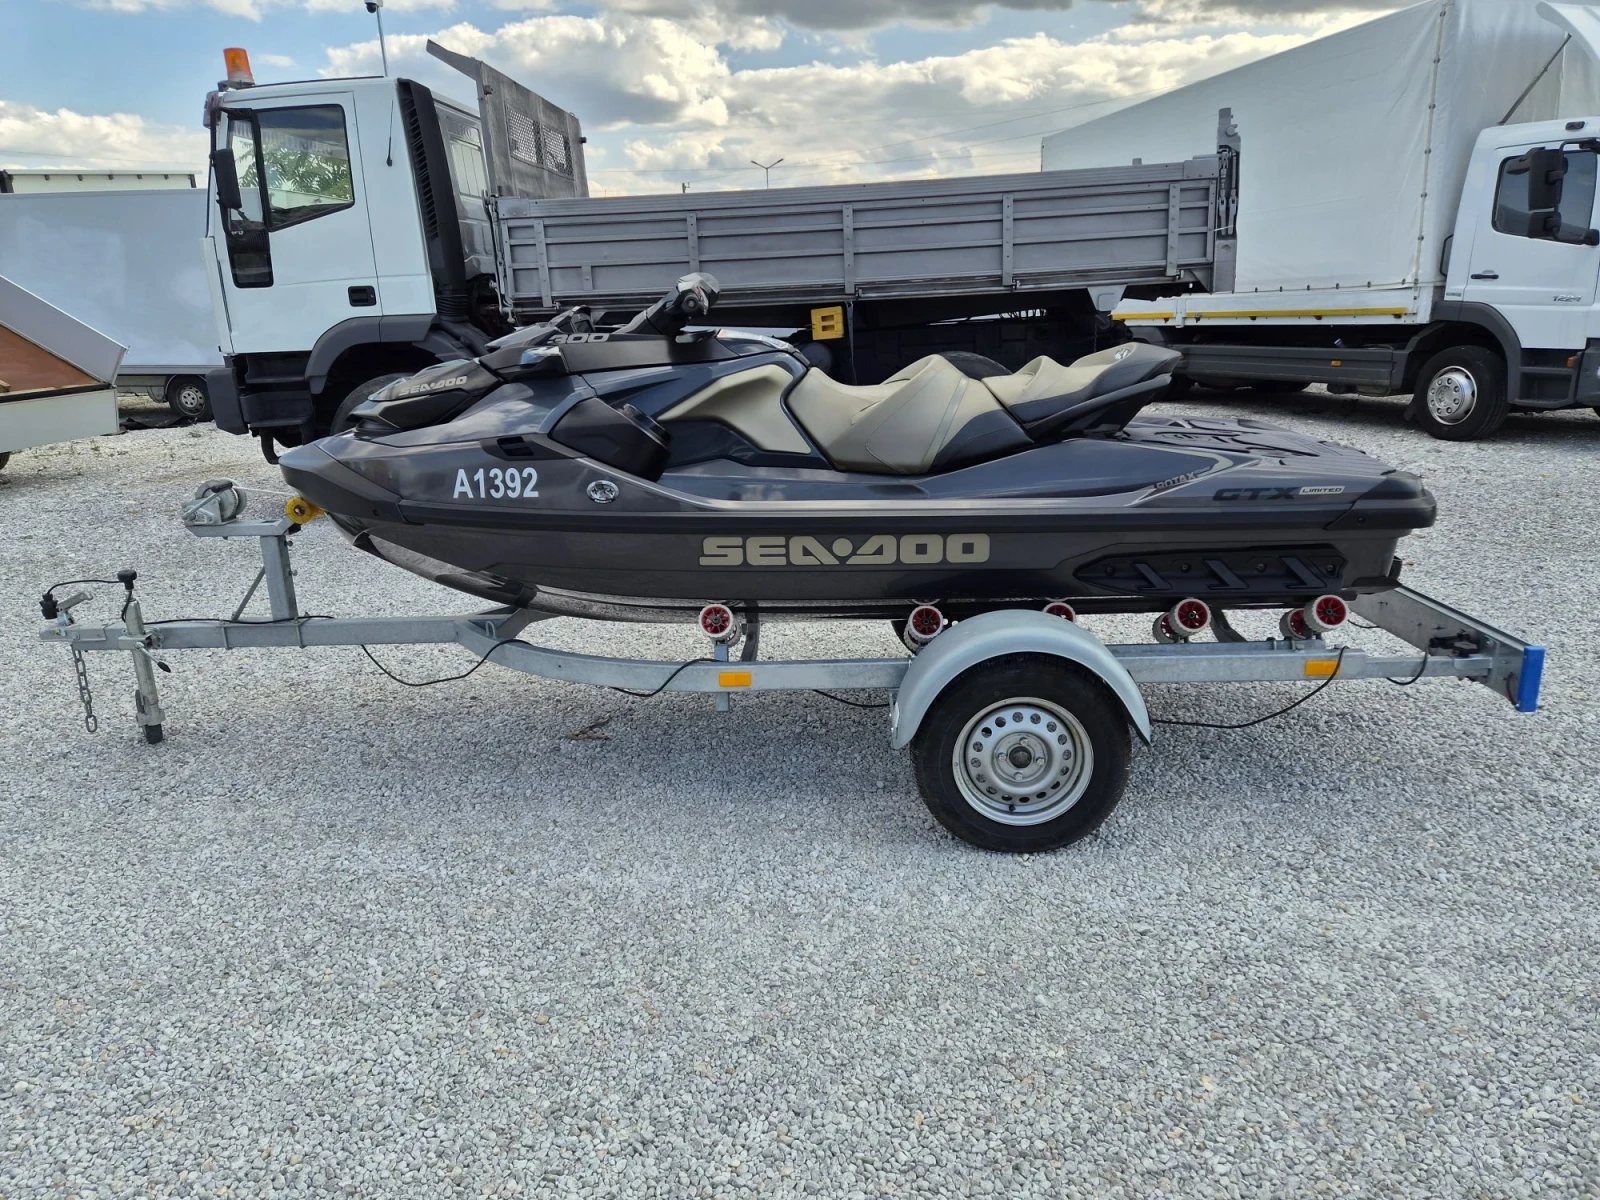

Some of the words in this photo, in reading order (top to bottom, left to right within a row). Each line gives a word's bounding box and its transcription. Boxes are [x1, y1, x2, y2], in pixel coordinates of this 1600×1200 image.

[452, 466, 539, 499] A1392
[1156, 471, 1196, 490] ROTAX
[1212, 486, 1300, 501] GTX
[1301, 486, 1343, 494] LIMITED
